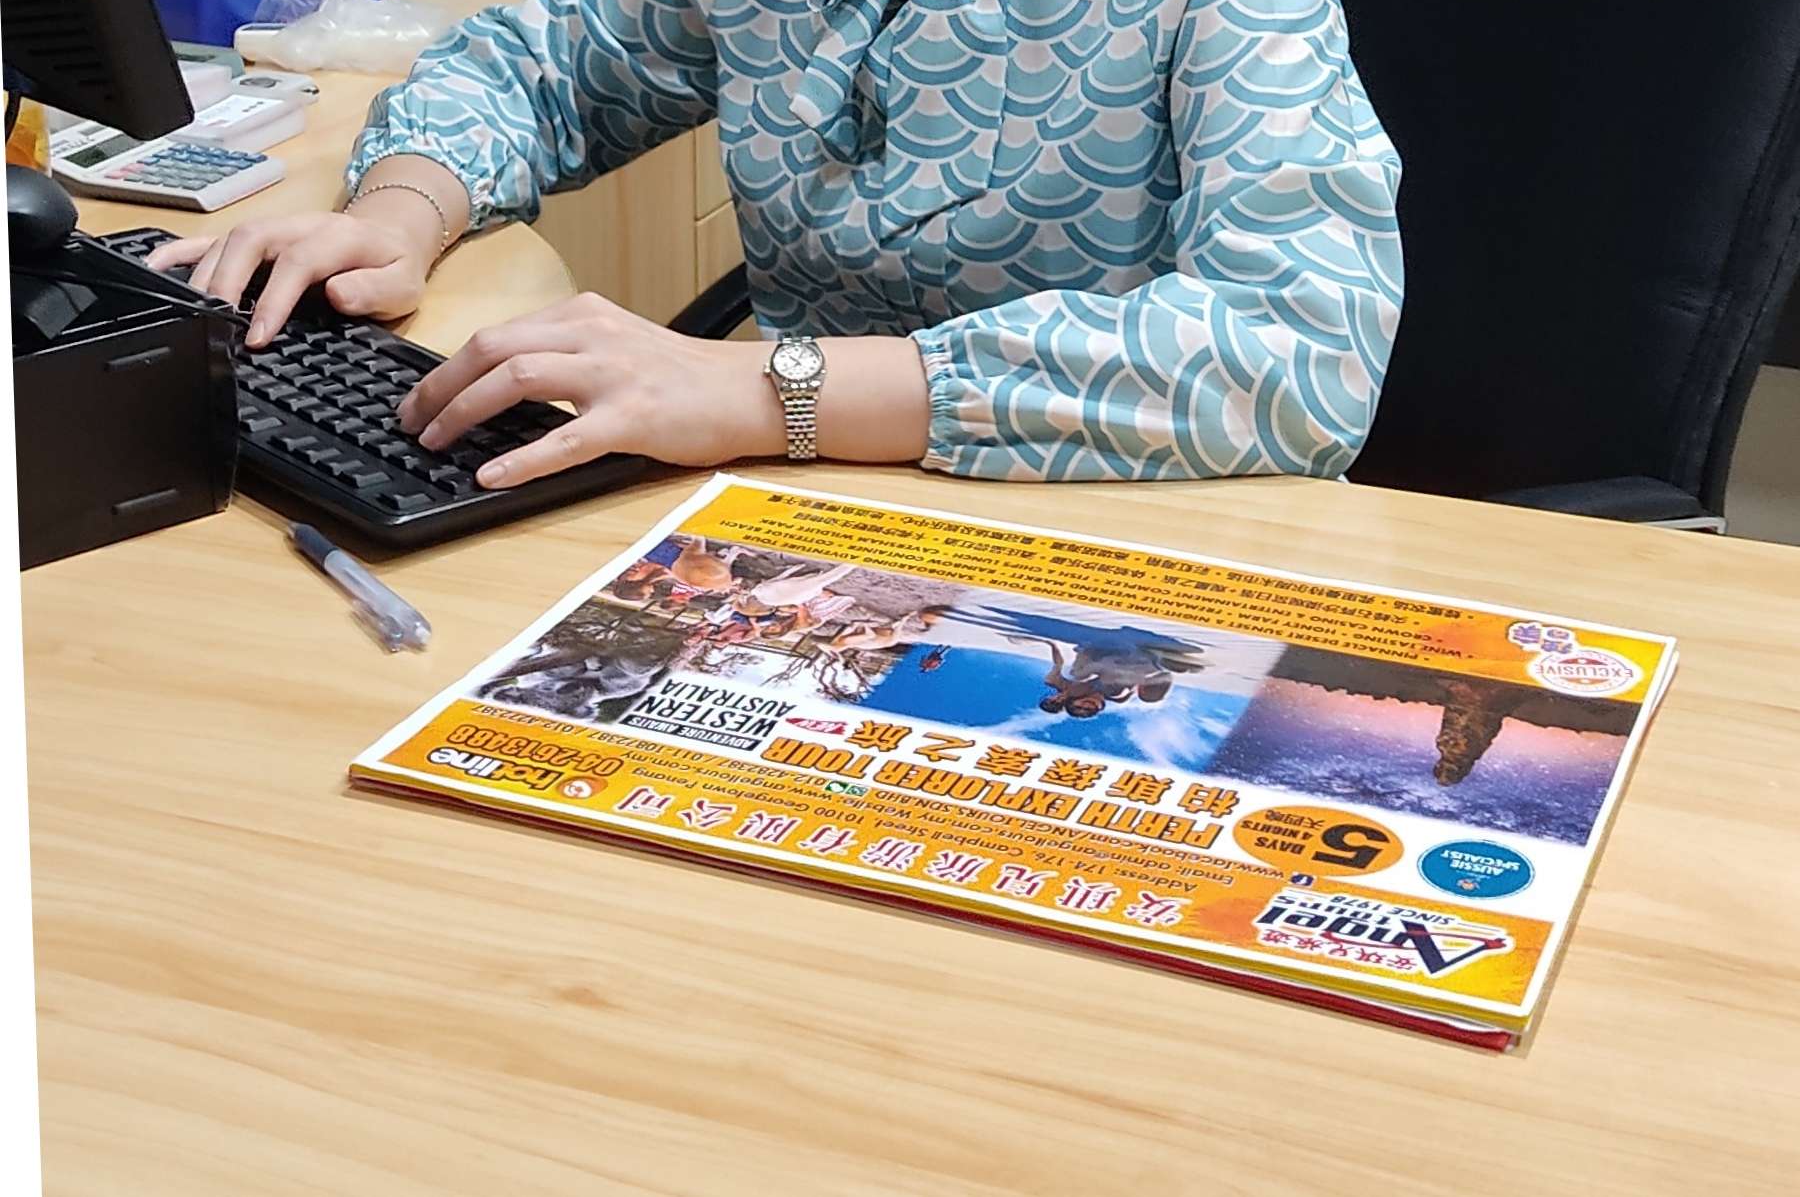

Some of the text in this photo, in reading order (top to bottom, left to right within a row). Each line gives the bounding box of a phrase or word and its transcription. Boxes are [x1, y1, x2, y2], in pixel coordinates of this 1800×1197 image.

[715, 519, 765, 532] BEACH
[755, 517, 796, 528] PARK
[853, 535, 941, 554] CAVERSHAM
[738, 534, 976, 581] SANDBOARDING ADVENTURE TOUR
[844, 543, 997, 574] RAINBOW CONTAINER
[949, 551, 1000, 565] LUNCH
[985, 578, 1027, 590] TOUR
[1056, 570, 1090, 581] FISH
[1100, 578, 1172, 595] COMPLEX
[1006, 571, 1223, 614] FREMANTLE WEEKEND MARKET
[1027, 585, 1123, 607] STARGAZING
[1225, 620, 1284, 636] SUNSET
[1235, 612, 1337, 635] HONEY FARM
[1307, 614, 1369, 630] CASINO
[1369, 625, 1433, 641] CROWN
[1285, 631, 1339, 645] DESERT
[1340, 641, 1419, 659] PINNACLE
[1420, 644, 1462, 657] WINE
[1535, 665, 1633, 678] EXCLUSIVE
[654, 678, 799, 718] AUSTRALIA
[630, 694, 781, 738] WESTERN
[790, 715, 842, 733] NEW
[625, 715, 756, 748] ADVENTURE AWAITS
[440, 723, 630, 777] 04-2613488
[424, 745, 564, 792] hotline
[627, 765, 701, 789] Penang
[716, 758, 827, 787] 012-4282387
[840, 717, 1245, 822] 柏斯探索之旅
[697, 780, 813, 813] Georgetown
[755, 735, 1224, 850] PERTH EXPLORER TOUR
[810, 805, 867, 824] 10100
[834, 795, 914, 818] Website:
[1239, 819, 1315, 841] 4 NIGHTS
[928, 828, 1027, 858] Campbell
[1252, 835, 1307, 855] DAYS
[1306, 818, 1395, 872] 5
[1439, 846, 1522, 871] SPECIALIST
[1448, 858, 1504, 876] AUSSIE
[1110, 867, 1198, 894] Address:
[1173, 865, 1235, 885] Email:
[1272, 893, 1392, 926] tours
[1328, 893, 1455, 927] SINCE 1978
[1259, 906, 1488, 975] Angel
